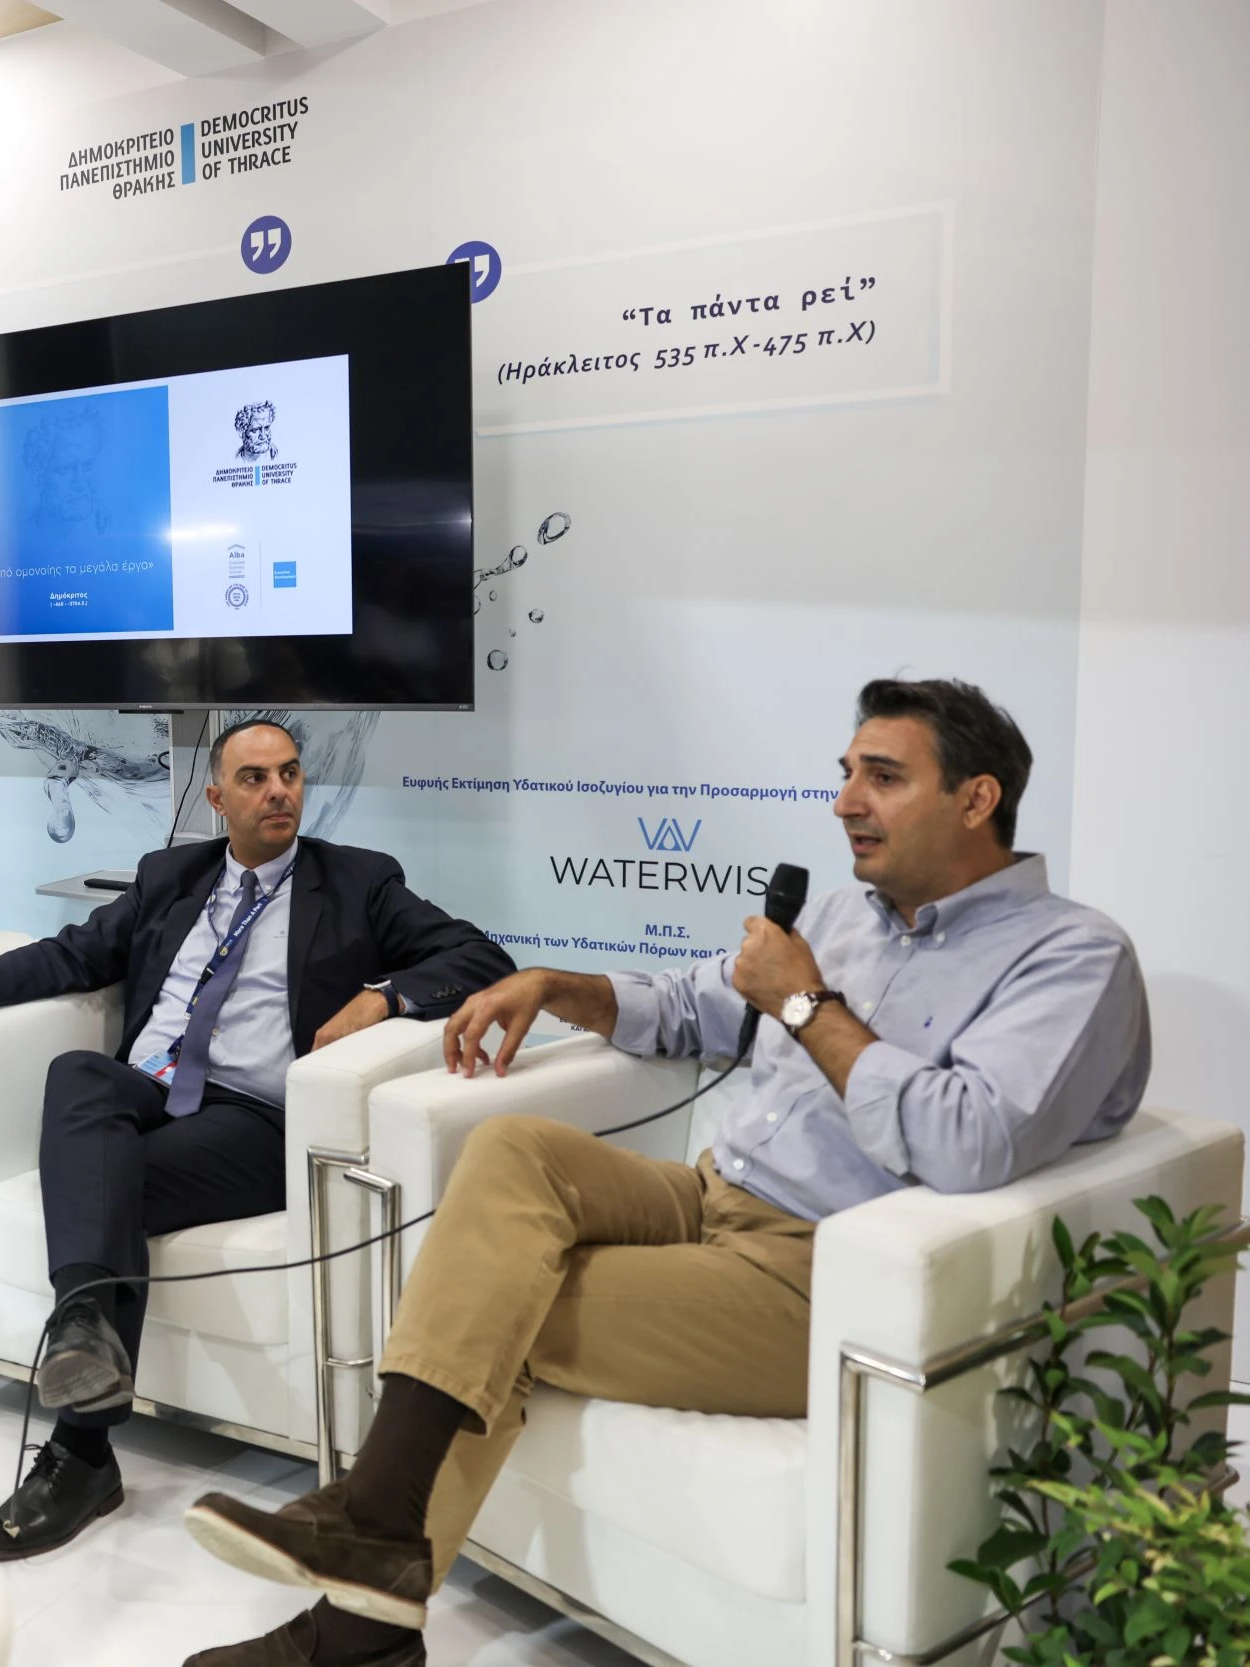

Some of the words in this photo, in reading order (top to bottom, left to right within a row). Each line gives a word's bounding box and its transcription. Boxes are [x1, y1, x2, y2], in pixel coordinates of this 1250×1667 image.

[200, 96, 309, 137] DEMOCRITUS
[68, 128, 174, 168] ΔΗΜΟΚΡΙΤΕΙΟ
[201, 121, 299, 159] UNIVERSITY
[60, 150, 175, 191] ΠΑΝΕΠΙΣΤΗΜΙΟ
[202, 163, 222, 180] OF
[228, 146, 291, 175] THRACE
[112, 171, 175, 200] ΘΡΑΚΗΣ
[690, 292, 781, 321] πάντα
[497, 348, 641, 385] (Ηράκλειτος
[654, 346, 696, 370] 535
[212, 473, 253, 482] ΠΑΝΕΠΙΣΤΗΜΙΟ
[215, 466, 253, 475] ΔΗΜΟΚΡΙΤΕΙΟ
[262, 462, 297, 471] DEMOCRITUS
[262, 470, 294, 478] UNIVERSITY
[65, 564, 77, 574] τα
[79, 560, 118, 575] μεγάλα
[402, 776, 449, 790] Ευφυής
[452, 777, 510, 793] Εκτίμηση
[512, 779, 573, 792] Υδατικού
[577, 780, 644, 796] Ισοζυγίου
[648, 784, 669, 797] για
[672, 785, 696, 798] την
[700, 783, 797, 801] Προσαρμογή
[801, 788, 839, 802] στην
[550, 855, 769, 896] WATERWIS
[645, 924, 690, 939] Μ.Π.Σ.
[544, 936, 568, 948] των
[572, 937, 636, 953] Υδατικών
[639, 942, 687, 958] Πόρων
[691, 947, 712, 959] και
